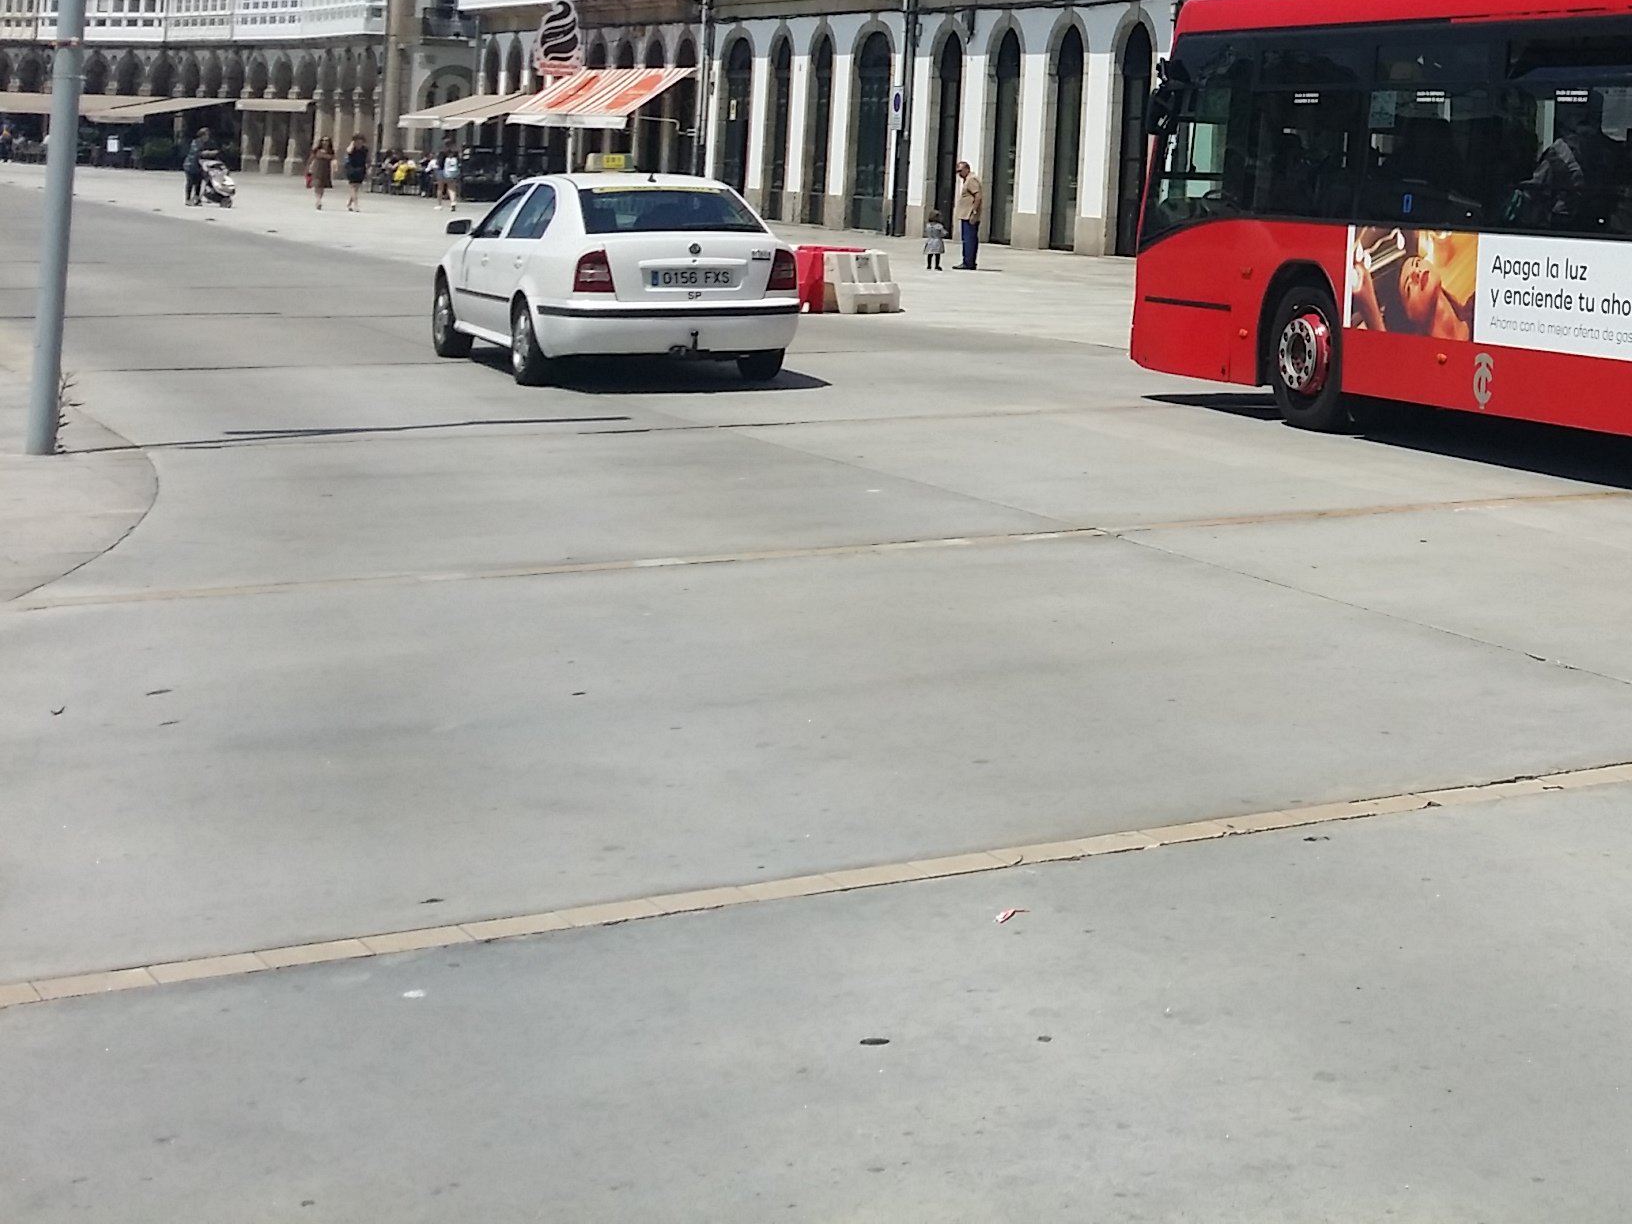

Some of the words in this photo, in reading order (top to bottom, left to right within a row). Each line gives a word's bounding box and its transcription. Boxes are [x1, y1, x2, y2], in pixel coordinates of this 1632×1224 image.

[663, 271, 698, 284] 0156
[704, 271, 730, 284] FXS
[1491, 255, 1540, 281] Apaga
[1546, 256, 1559, 279] la
[1565, 258, 1588, 281] luz
[688, 291, 702, 300] SP
[1490, 287, 1499, 308] y
[1504, 286, 1573, 311] enciende
[1578, 292, 1595, 313] tu
[1520, 321, 1535, 333] con
[1537, 320, 1546, 334] la
[1547, 322, 1571, 339] mejor
[1573, 325, 1600, 340] oferta
[1602, 327, 1614, 342] de
